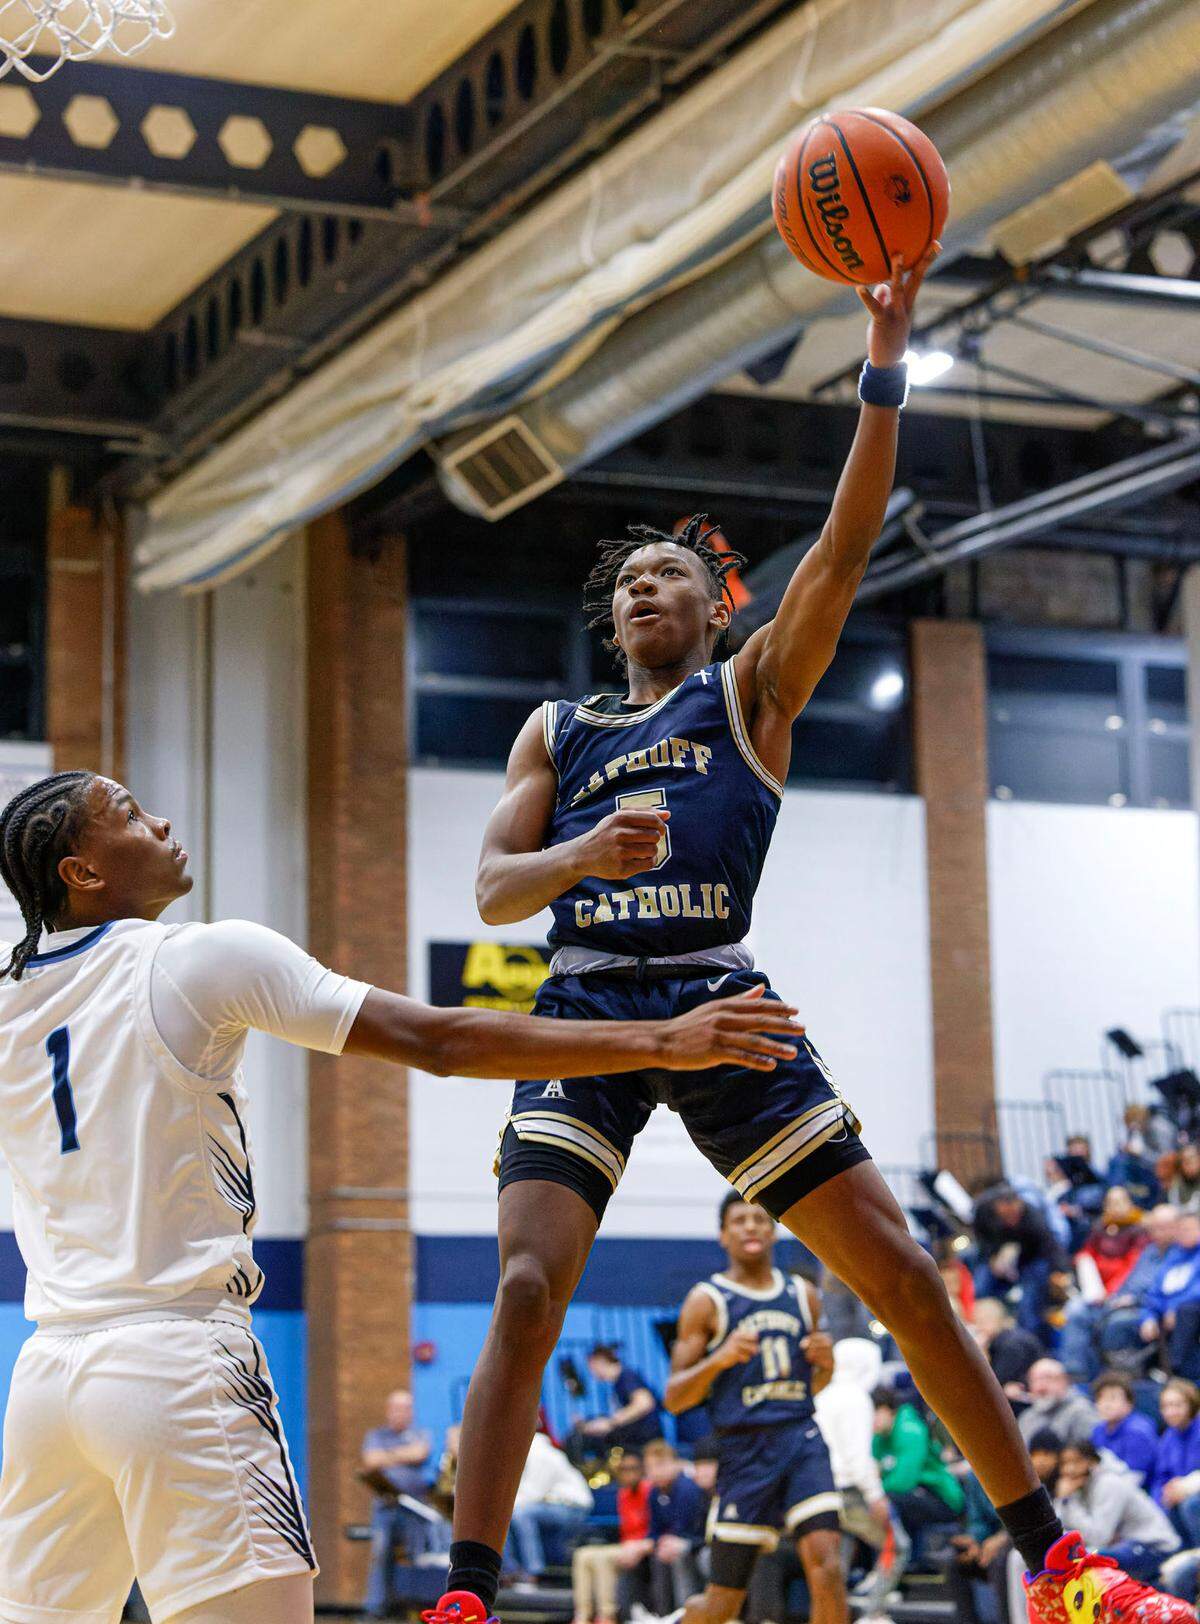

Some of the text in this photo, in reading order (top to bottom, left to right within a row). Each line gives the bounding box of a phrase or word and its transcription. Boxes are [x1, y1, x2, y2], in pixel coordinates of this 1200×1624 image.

[808, 151, 865, 271] Wilson
[615, 787, 672, 871] 5
[574, 883, 731, 929] CATHOLIC
[45, 1023, 81, 1155] 1
[760, 1335, 792, 1381] 11
